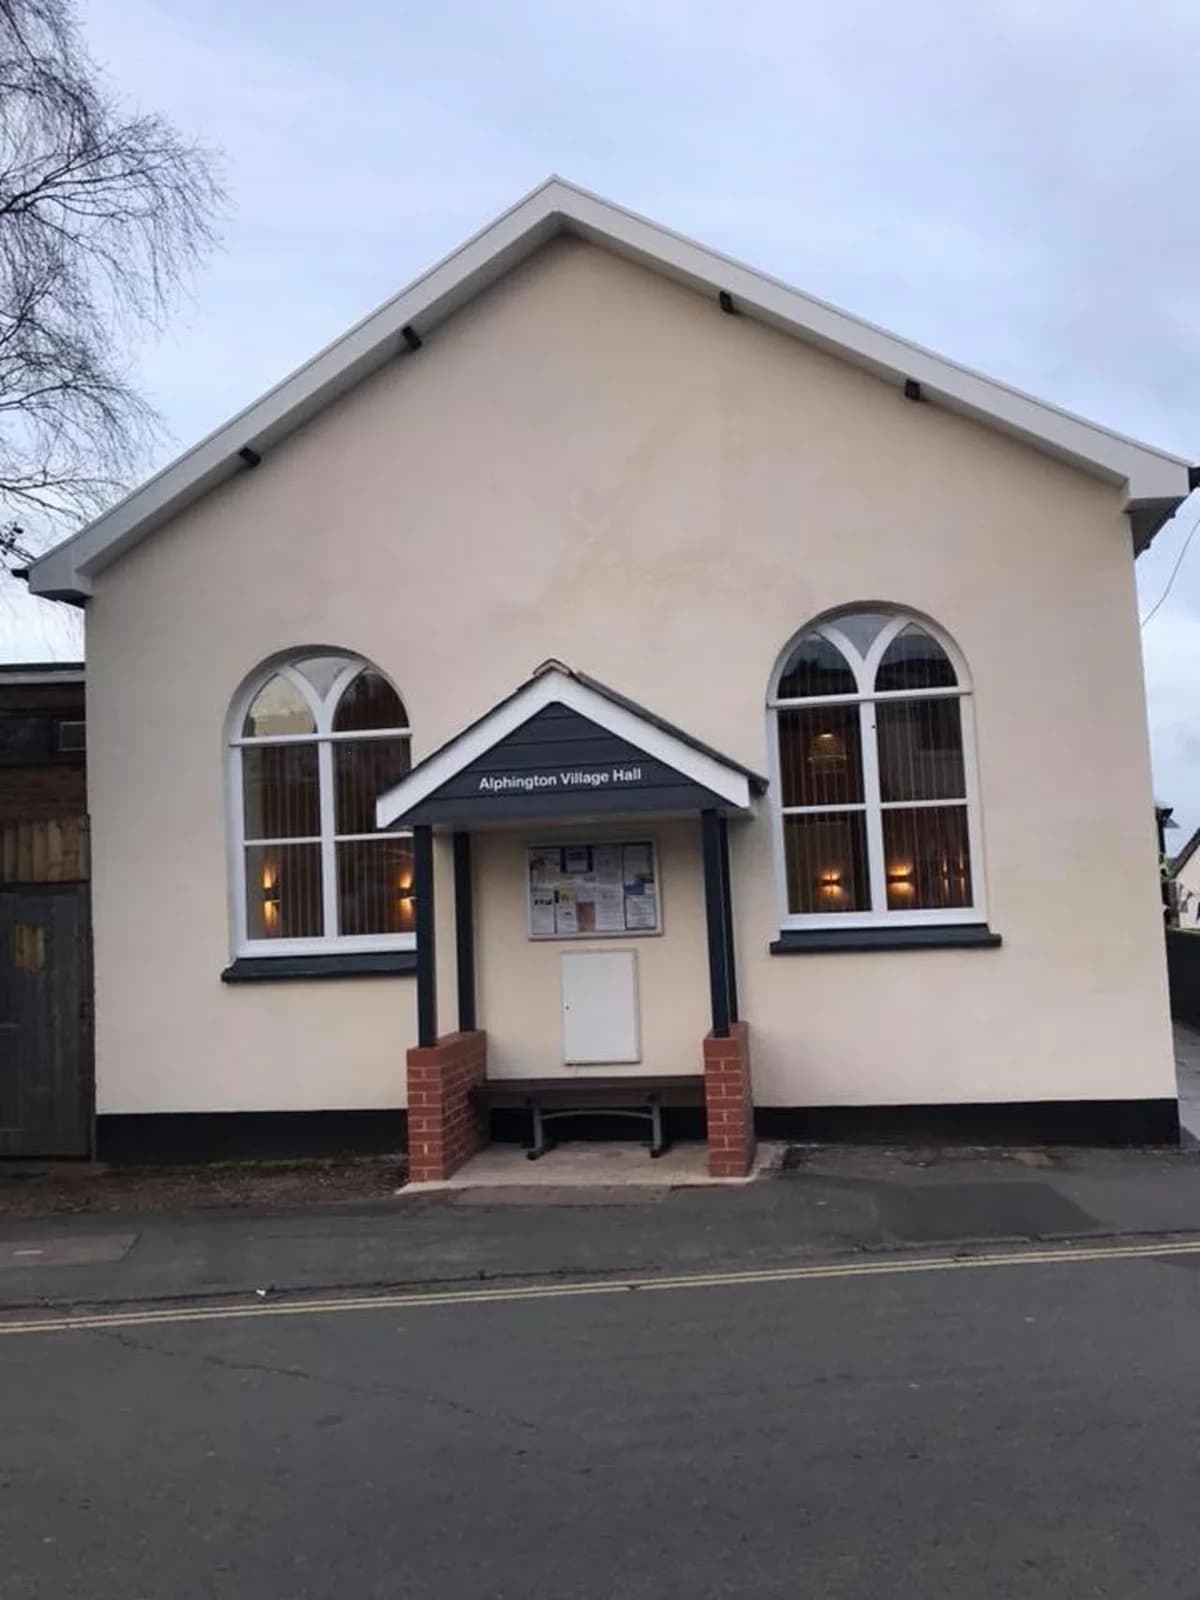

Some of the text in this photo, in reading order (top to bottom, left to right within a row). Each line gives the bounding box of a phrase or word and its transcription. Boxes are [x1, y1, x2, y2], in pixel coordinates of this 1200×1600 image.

[479, 768, 642, 792] Alphington Village Hall
